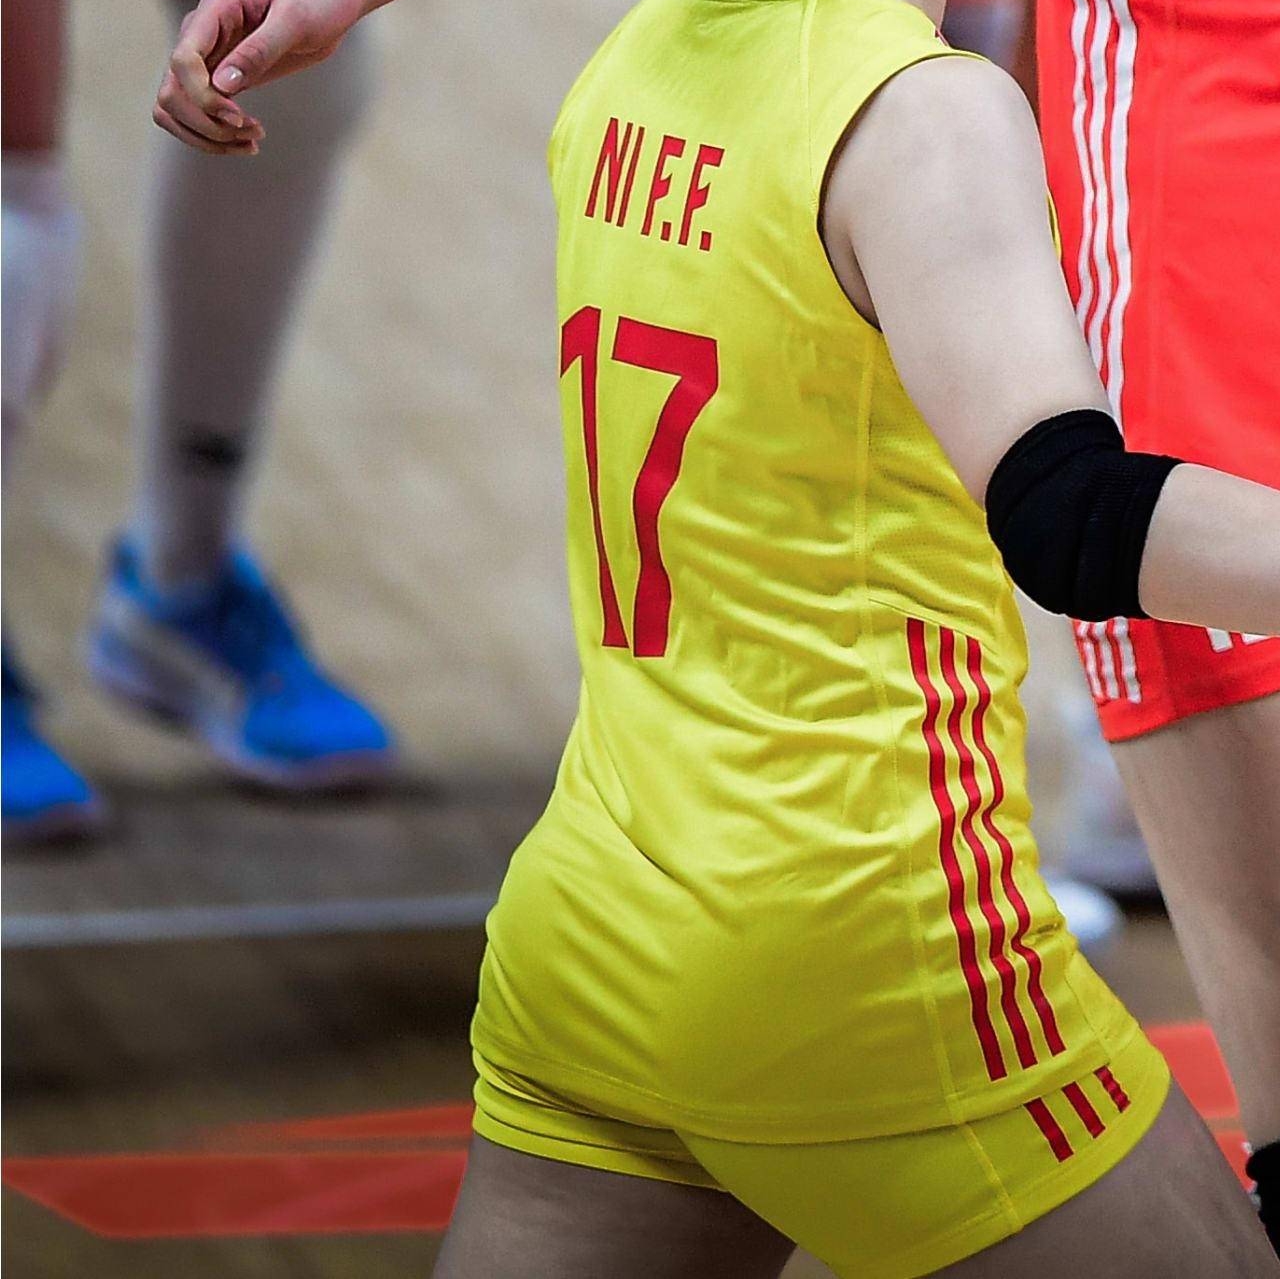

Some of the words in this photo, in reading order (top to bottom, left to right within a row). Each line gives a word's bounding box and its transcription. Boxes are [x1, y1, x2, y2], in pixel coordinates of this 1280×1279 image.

[584, 116, 646, 228] NI
[640, 133, 726, 252] F.F.
[559, 304, 719, 659] 17
